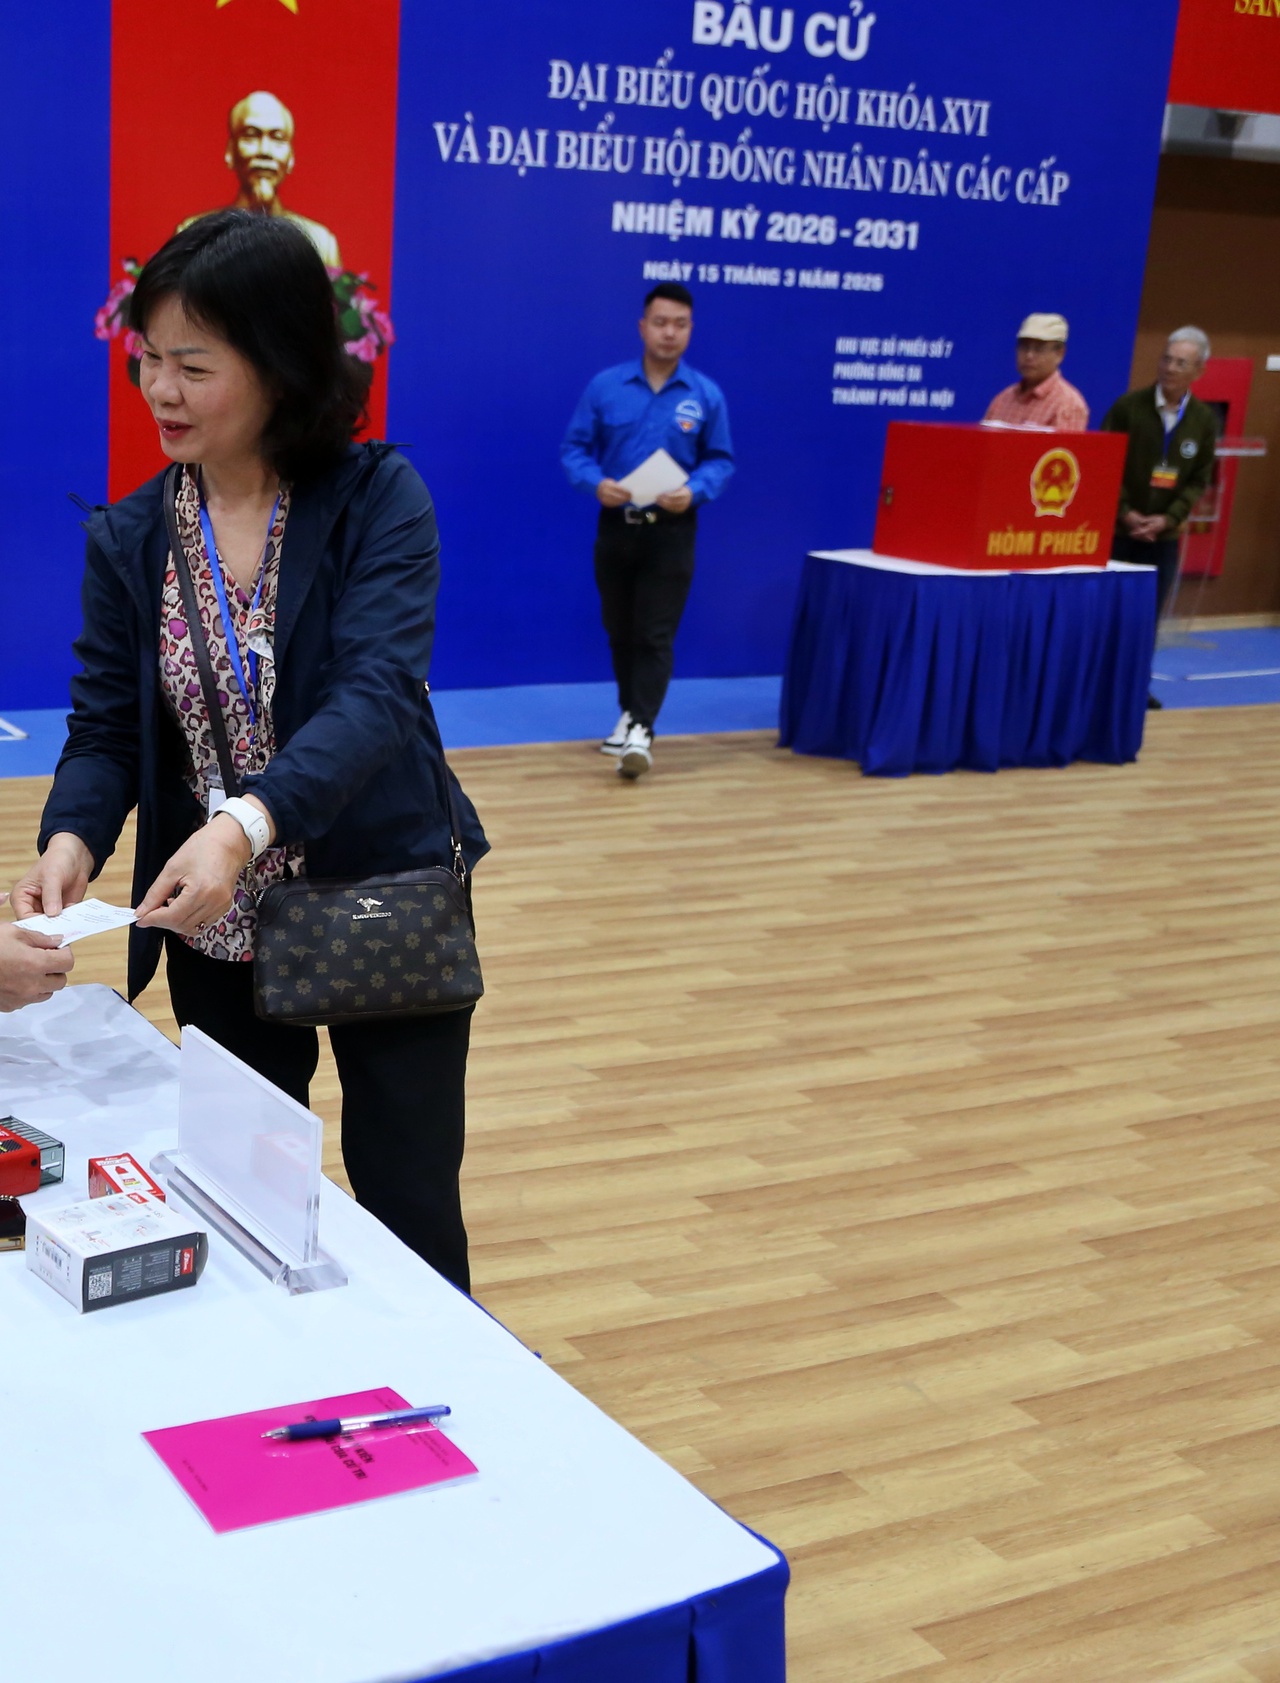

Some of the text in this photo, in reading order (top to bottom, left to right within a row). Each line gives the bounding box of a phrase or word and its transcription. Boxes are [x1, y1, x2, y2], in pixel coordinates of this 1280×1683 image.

[804, 0, 876, 61] CỬ
[548, 47, 991, 137] ĐẠI BIỂU QUỐC HỘI KHÓA XVI
[433, 111, 1070, 206] VÀ ĐẠI BIỂU HỘI ĐỒNG NHÂN DÂN CÁC CẤP
[612, 199, 714, 242] NHIỆM
[643, 260, 884, 292] NGÀY 15 THÁNG 3 NĂM 2026
[835, 336, 858, 355] KHU
[928, 335, 945, 358] SỐ
[832, 384, 956, 410] THÀNH PHỐ HÀ NỘI
[986, 520, 1100, 556] HÒM PHIẾU
